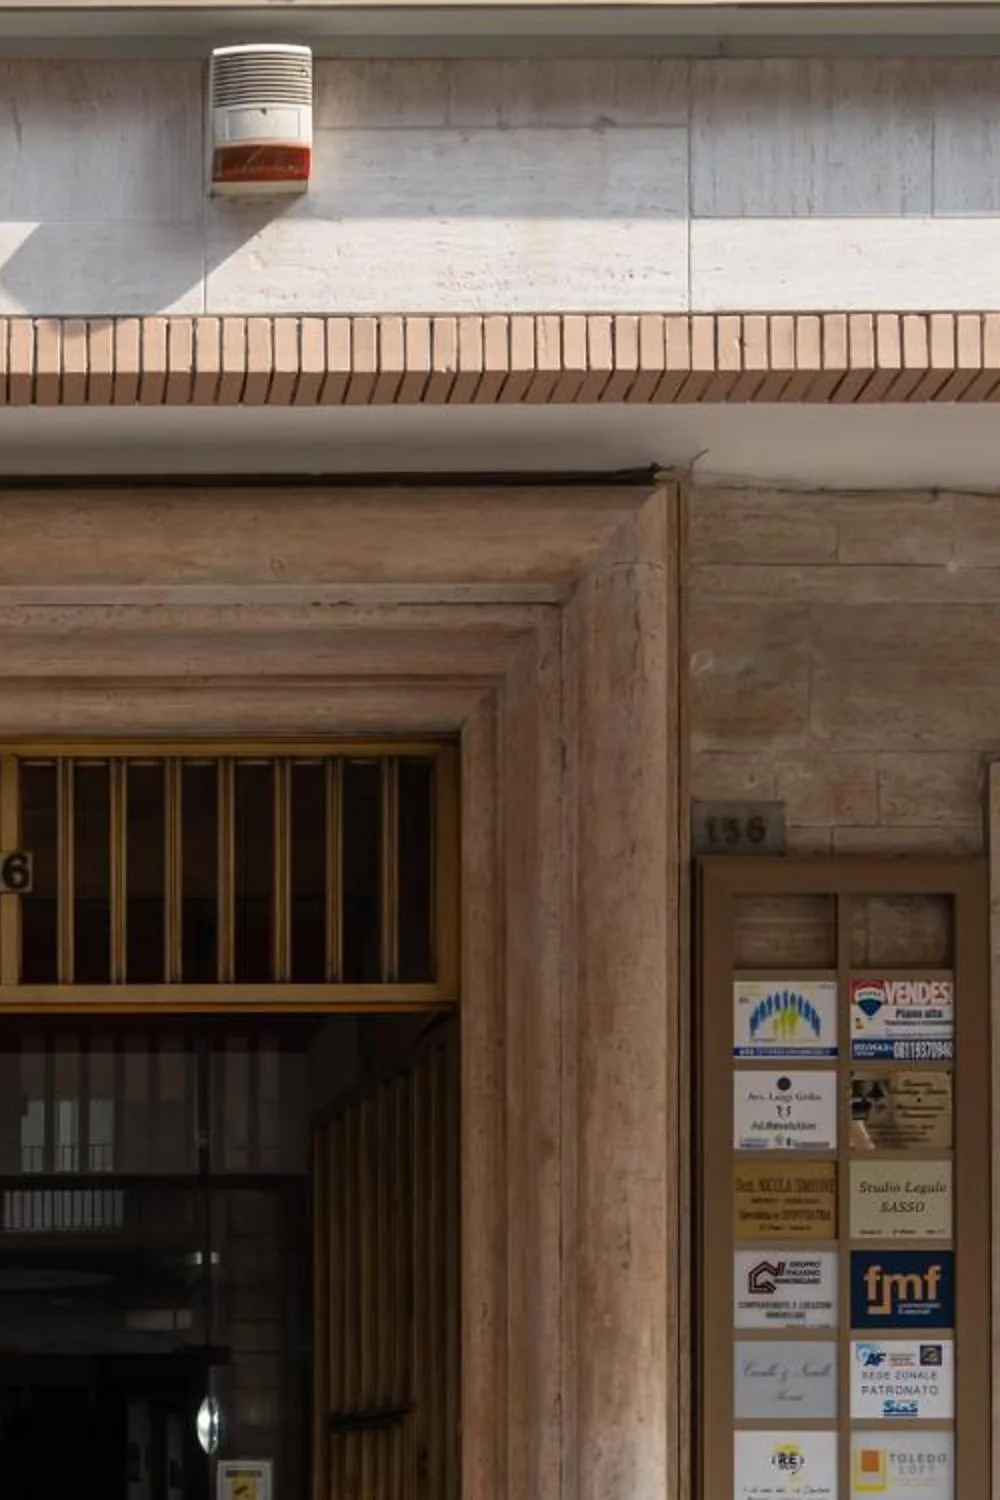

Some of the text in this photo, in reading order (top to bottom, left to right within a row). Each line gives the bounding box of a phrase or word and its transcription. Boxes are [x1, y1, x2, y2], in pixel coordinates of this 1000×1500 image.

[884, 981, 951, 1005] VENDES
[859, 1181, 947, 1196] Studio Legale
[879, 1201, 926, 1213] SASSO
[861, 1385, 939, 1395] PATRONATO
[889, 1453, 947, 1463] TOLEDO
